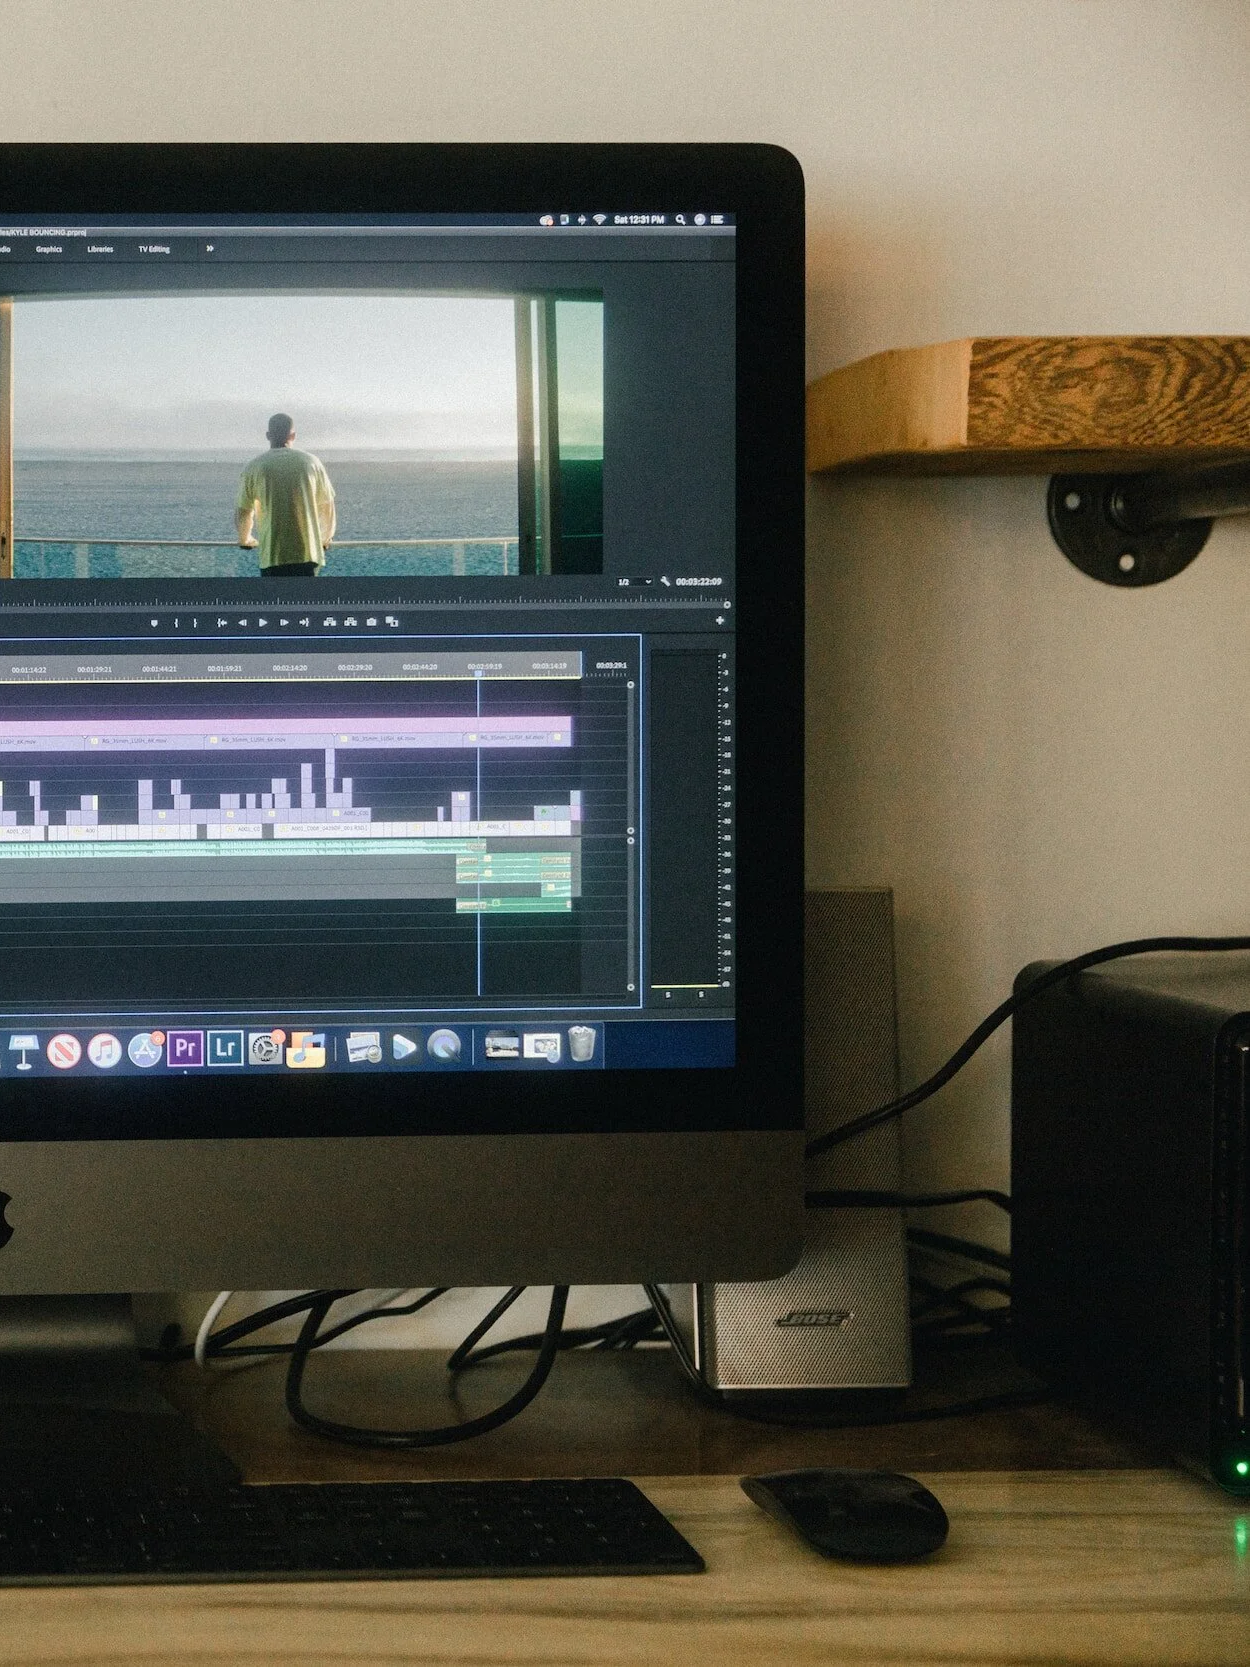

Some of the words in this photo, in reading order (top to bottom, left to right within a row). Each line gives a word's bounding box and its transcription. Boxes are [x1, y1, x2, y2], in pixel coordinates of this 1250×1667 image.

[613, 214, 628, 225] Sat
[629, 214, 650, 225] 12:31
[651, 214, 665, 225] PM
[36, 245, 62, 255] Graphics
[88, 245, 114, 253] Libraries
[139, 245, 148, 253] TV
[149, 245, 171, 255] Editing
[618, 578, 630, 587] 1/2
[675, 577, 723, 587] 00:03:22:09
[175, 1038, 196, 1057] Pr
[216, 1037, 235, 1057] Lr
[789, 1313, 847, 1325] BOSE
